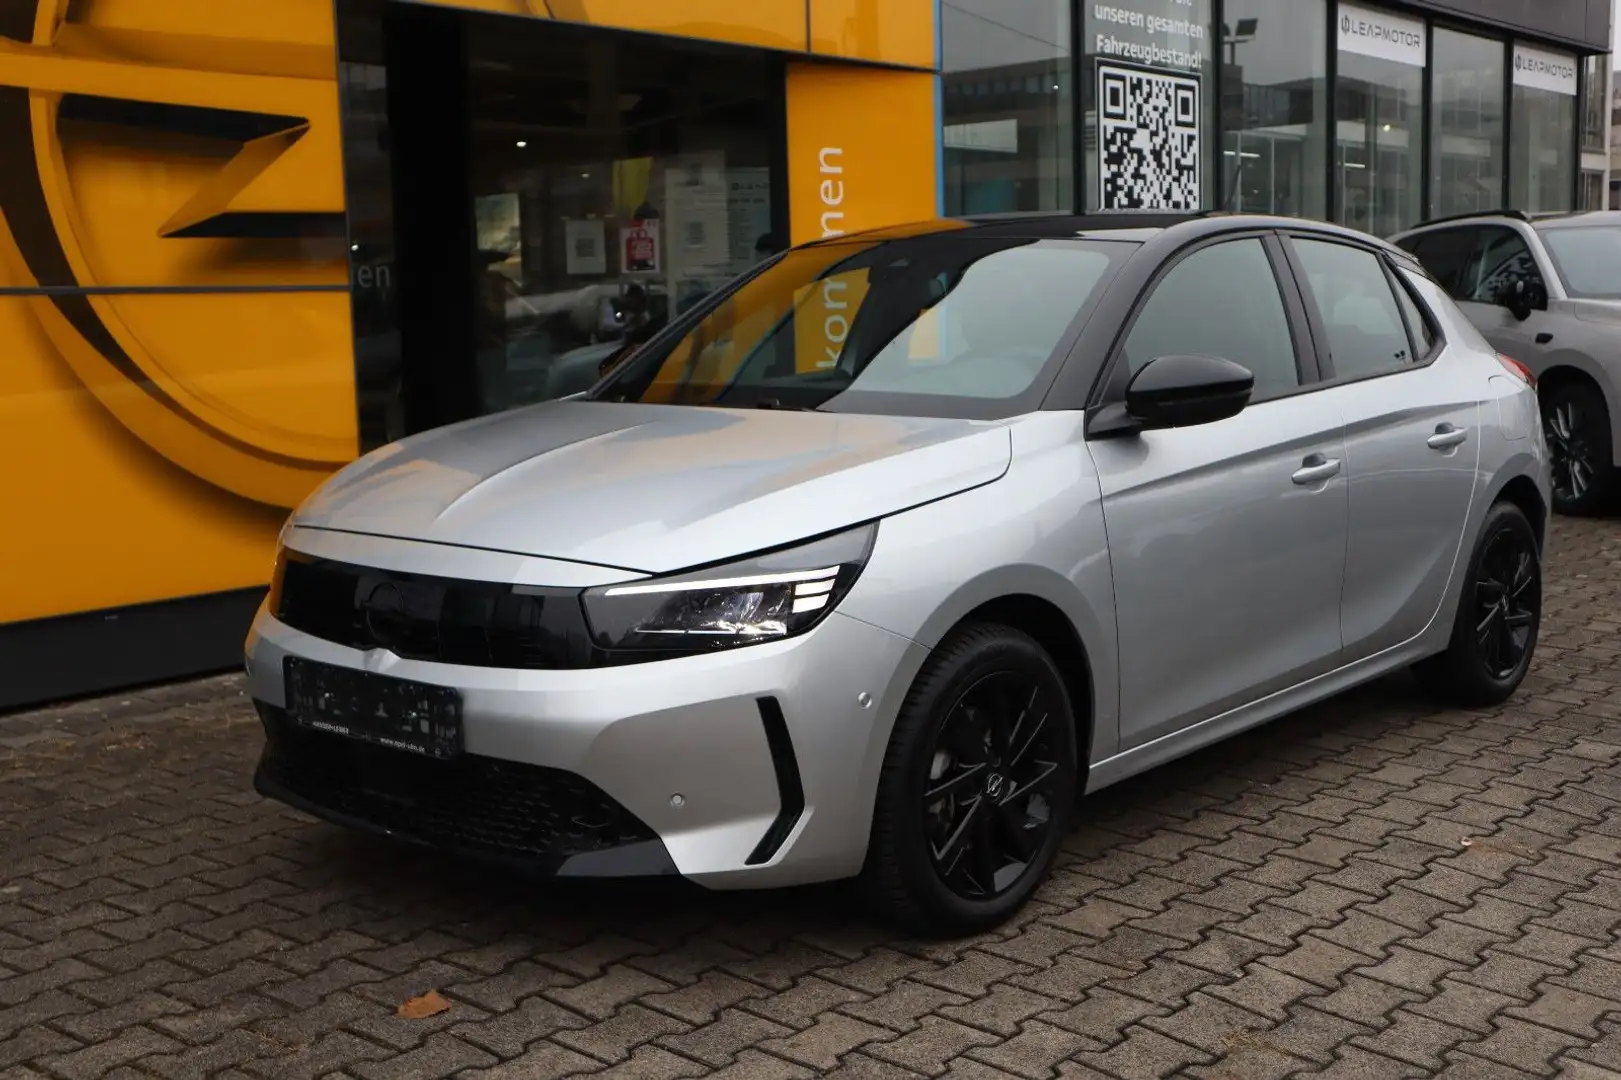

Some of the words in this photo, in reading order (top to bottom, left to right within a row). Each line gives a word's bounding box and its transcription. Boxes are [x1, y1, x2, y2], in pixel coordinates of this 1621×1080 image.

[1094, 4, 1144, 28] unseren
[1146, 15, 1203, 39] gesamten
[1351, 19, 1421, 48] LEAPMOTOR
[1096, 34, 1203, 68] Fahrzeugbestand!
[1522, 57, 1573, 79] LEAPMOTOR
